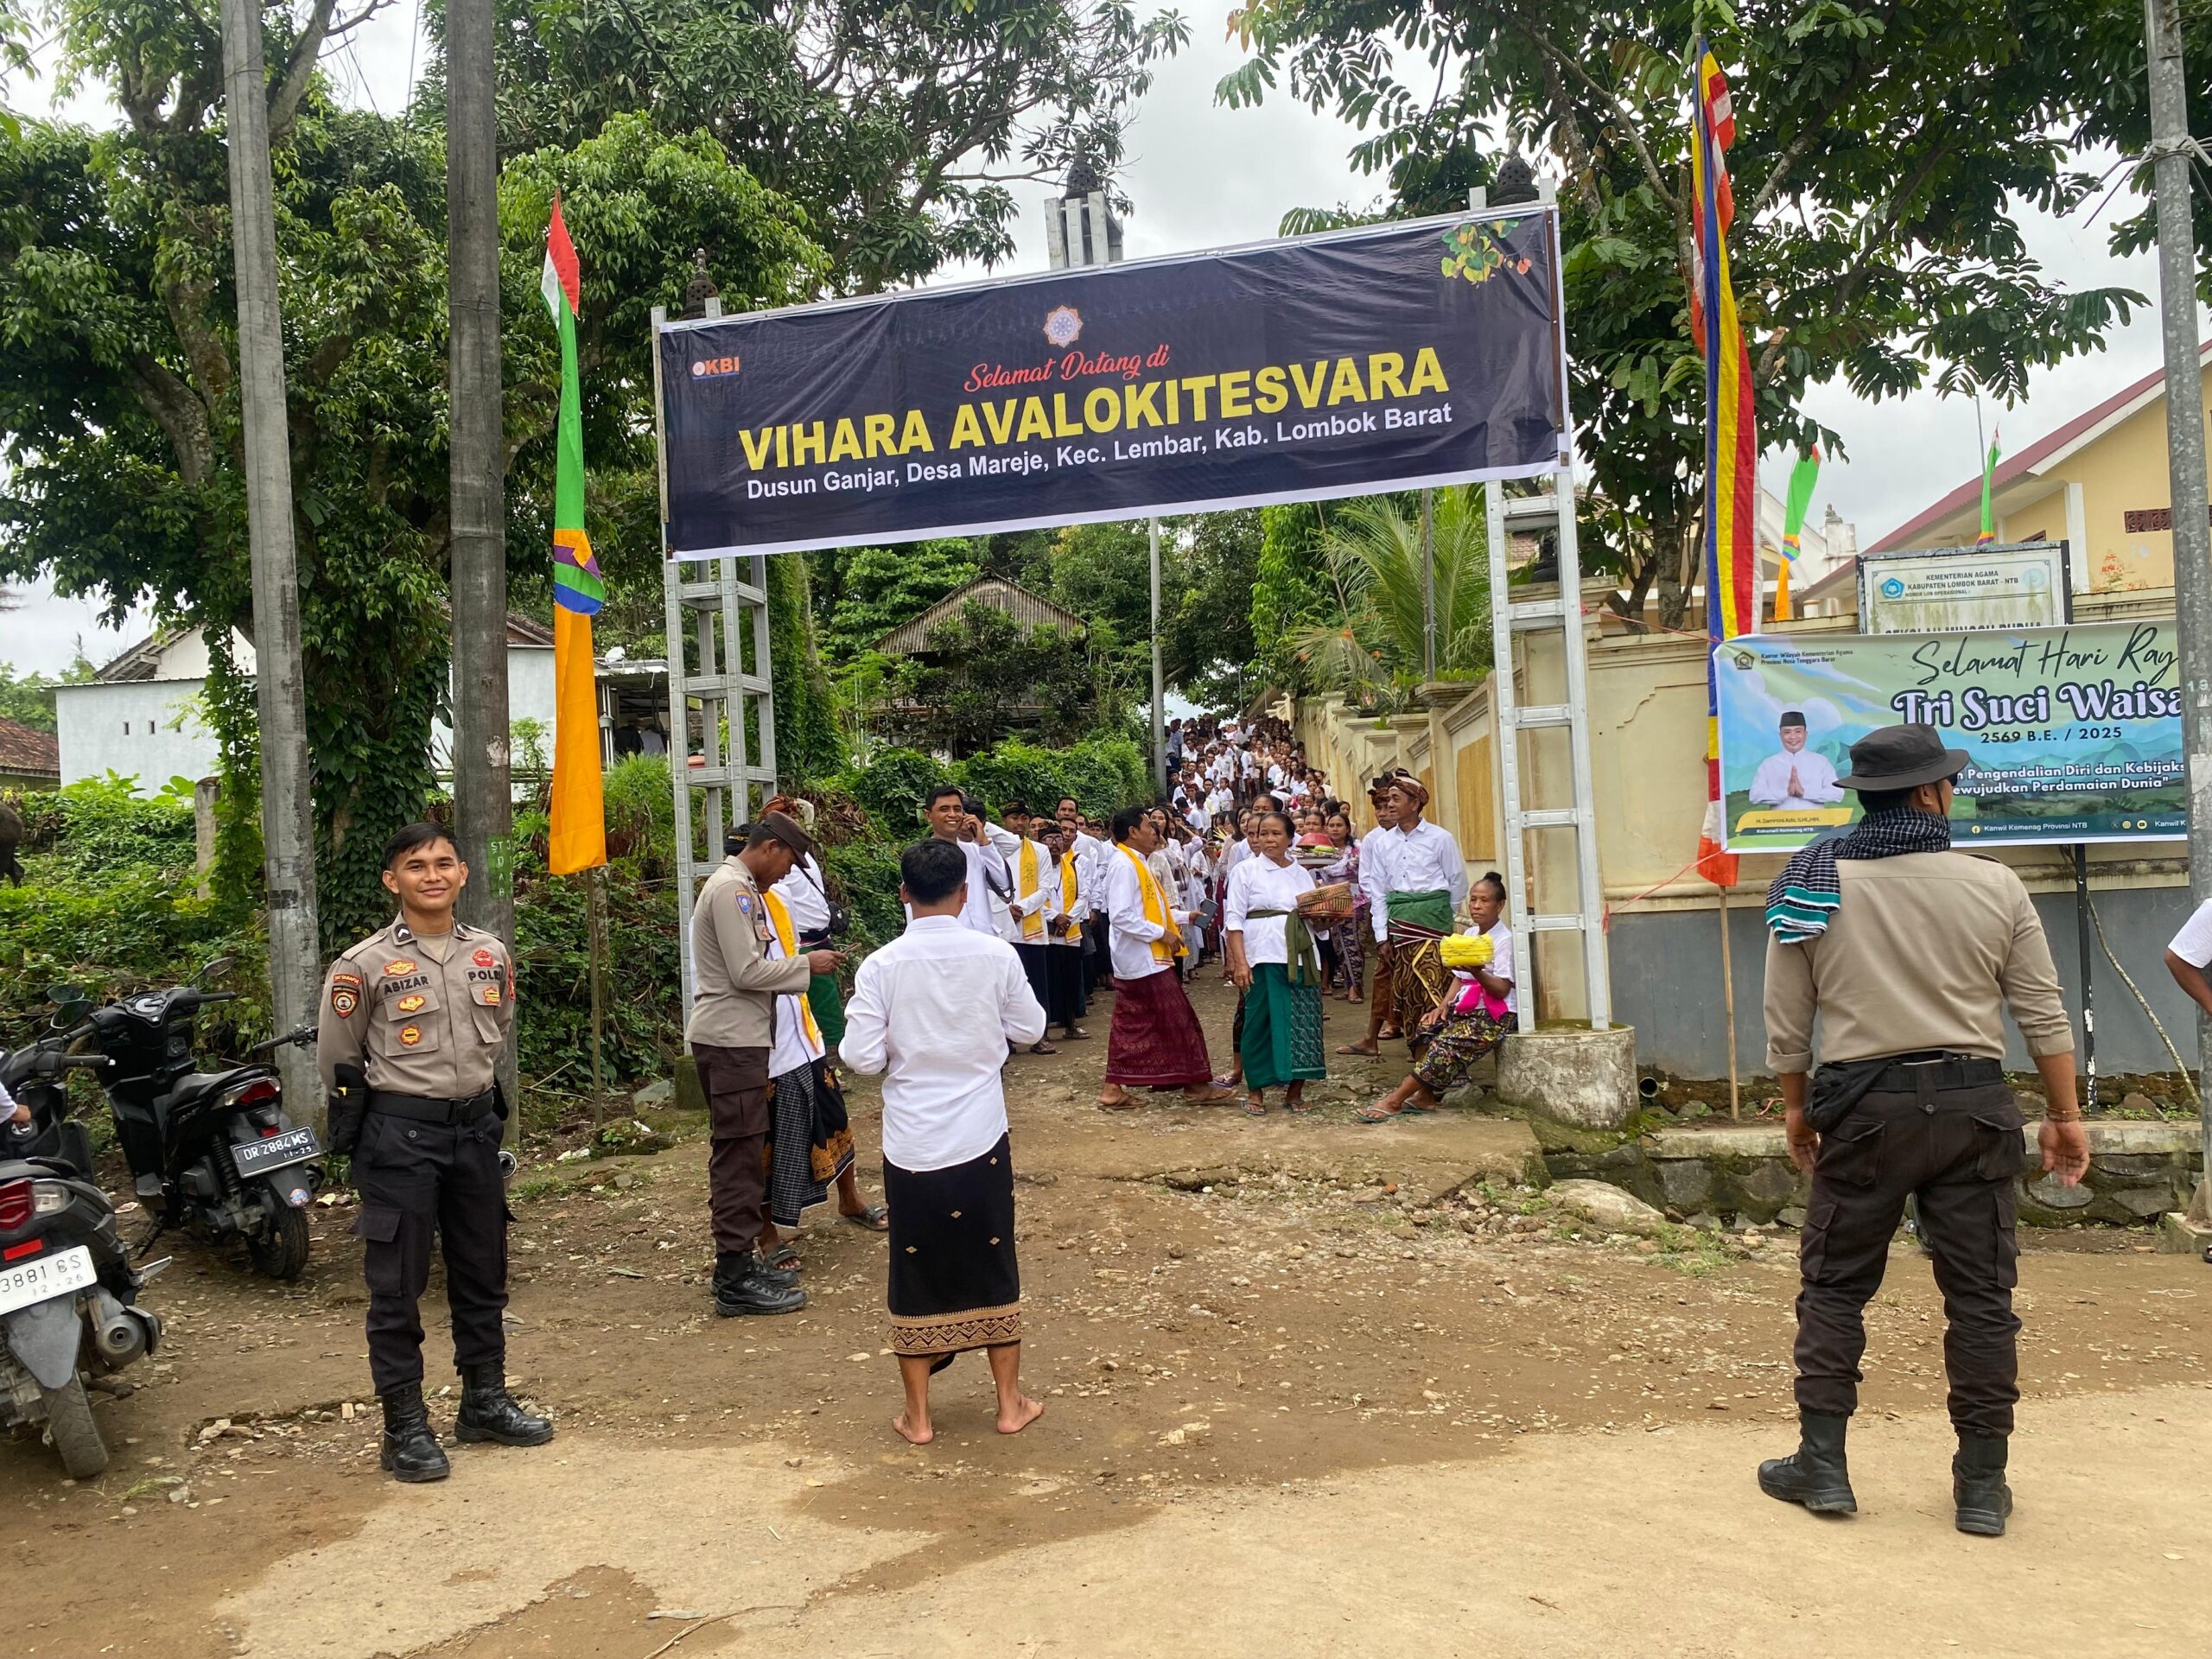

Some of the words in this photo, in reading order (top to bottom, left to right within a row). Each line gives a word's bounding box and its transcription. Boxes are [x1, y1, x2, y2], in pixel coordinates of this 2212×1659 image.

[704, 356, 740, 375] KBI
[963, 358, 1056, 392] Selamat
[1060, 351, 1141, 381] Datang
[1146, 344, 1170, 367] di
[738, 410, 934, 471] VIHARA
[950, 346, 1449, 449] AVALOKITESVARA
[747, 478, 817, 499] Dusun
[823, 467, 899, 492] Ganjar,
[906, 462, 962, 482] Desa
[969, 450, 1049, 476] Mareje,
[1056, 445, 1106, 467] Kec.
[1114, 435, 1207, 461] Lembar,
[1215, 427, 1268, 449] Kab.
[1276, 412, 1377, 442] Lombok
[1384, 402, 1452, 429] Barat
[1926, 572, 1973, 581] KEMENTERIAN
[1911, 636, 2041, 685] Selamat
[2037, 630, 2108, 677] Hari
[2117, 623, 2179, 686] Ray
[1891, 690, 1953, 727] Tri
[1961, 685, 2050, 729] Suci
[2056, 679, 2182, 721] Waisa
[1980, 730, 2021, 744] 2569
[2027, 729, 2057, 741] B.E.
[2064, 728, 2072, 742] /
[2079, 726, 2122, 740] 2025
[1967, 766, 2062, 781] Pengendalian
[2066, 764, 2090, 776] Diri
[2094, 763, 2121, 774] dan
[2126, 760, 2184, 775] Kebijaks
[1953, 782, 2028, 797] ewujudkan
[2032, 779, 2117, 792] Perdamaian
[2121, 776, 2169, 789] Dunia"
[384, 976, 429, 995] ABIZAR
[243, 1147, 260, 1160] DR
[261, 1138, 291, 1155] 2884
[291, 1133, 308, 1146] MS
[1, 1265, 47, 1293] 3881
